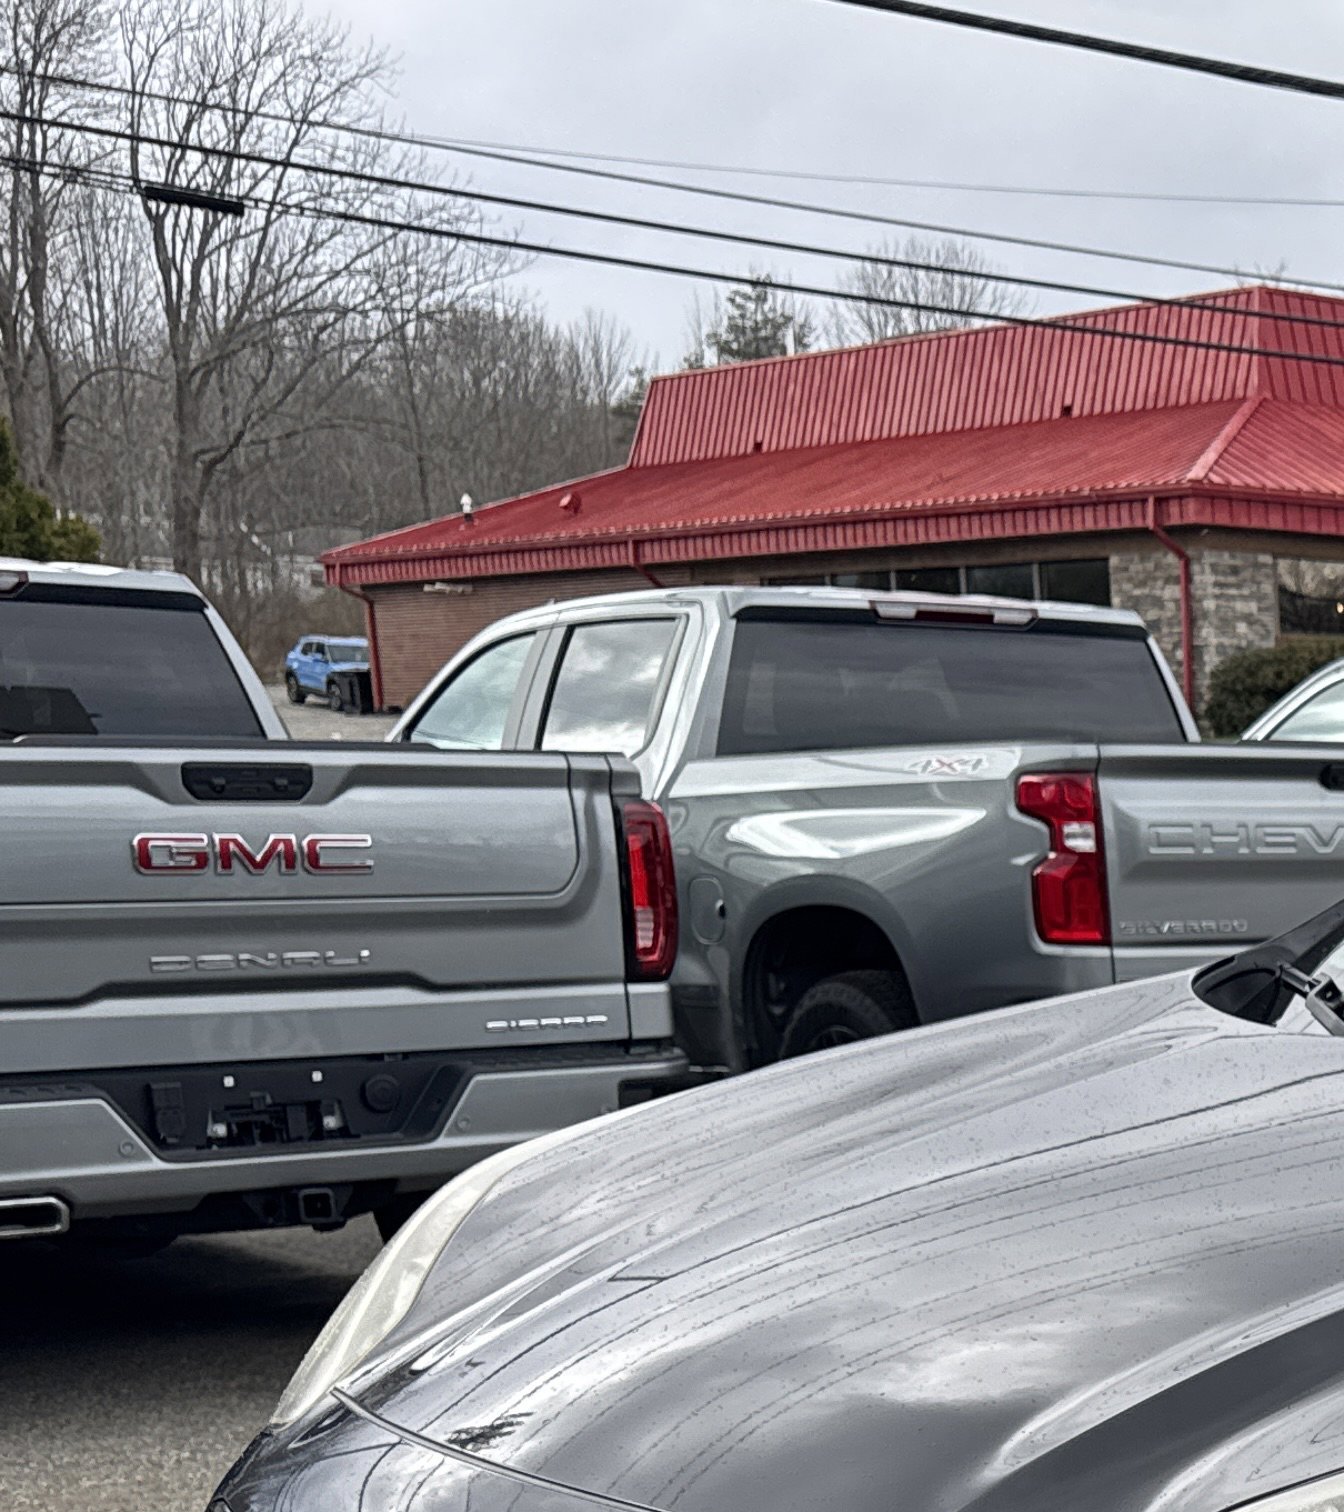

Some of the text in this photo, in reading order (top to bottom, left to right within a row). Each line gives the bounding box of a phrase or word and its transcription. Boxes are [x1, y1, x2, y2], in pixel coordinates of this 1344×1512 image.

[131, 832, 374, 876] GMC
[1119, 918, 1248, 936] SILVERADO
[150, 949, 371, 974] DENALI
[485, 1014, 608, 1033] SIERRA
